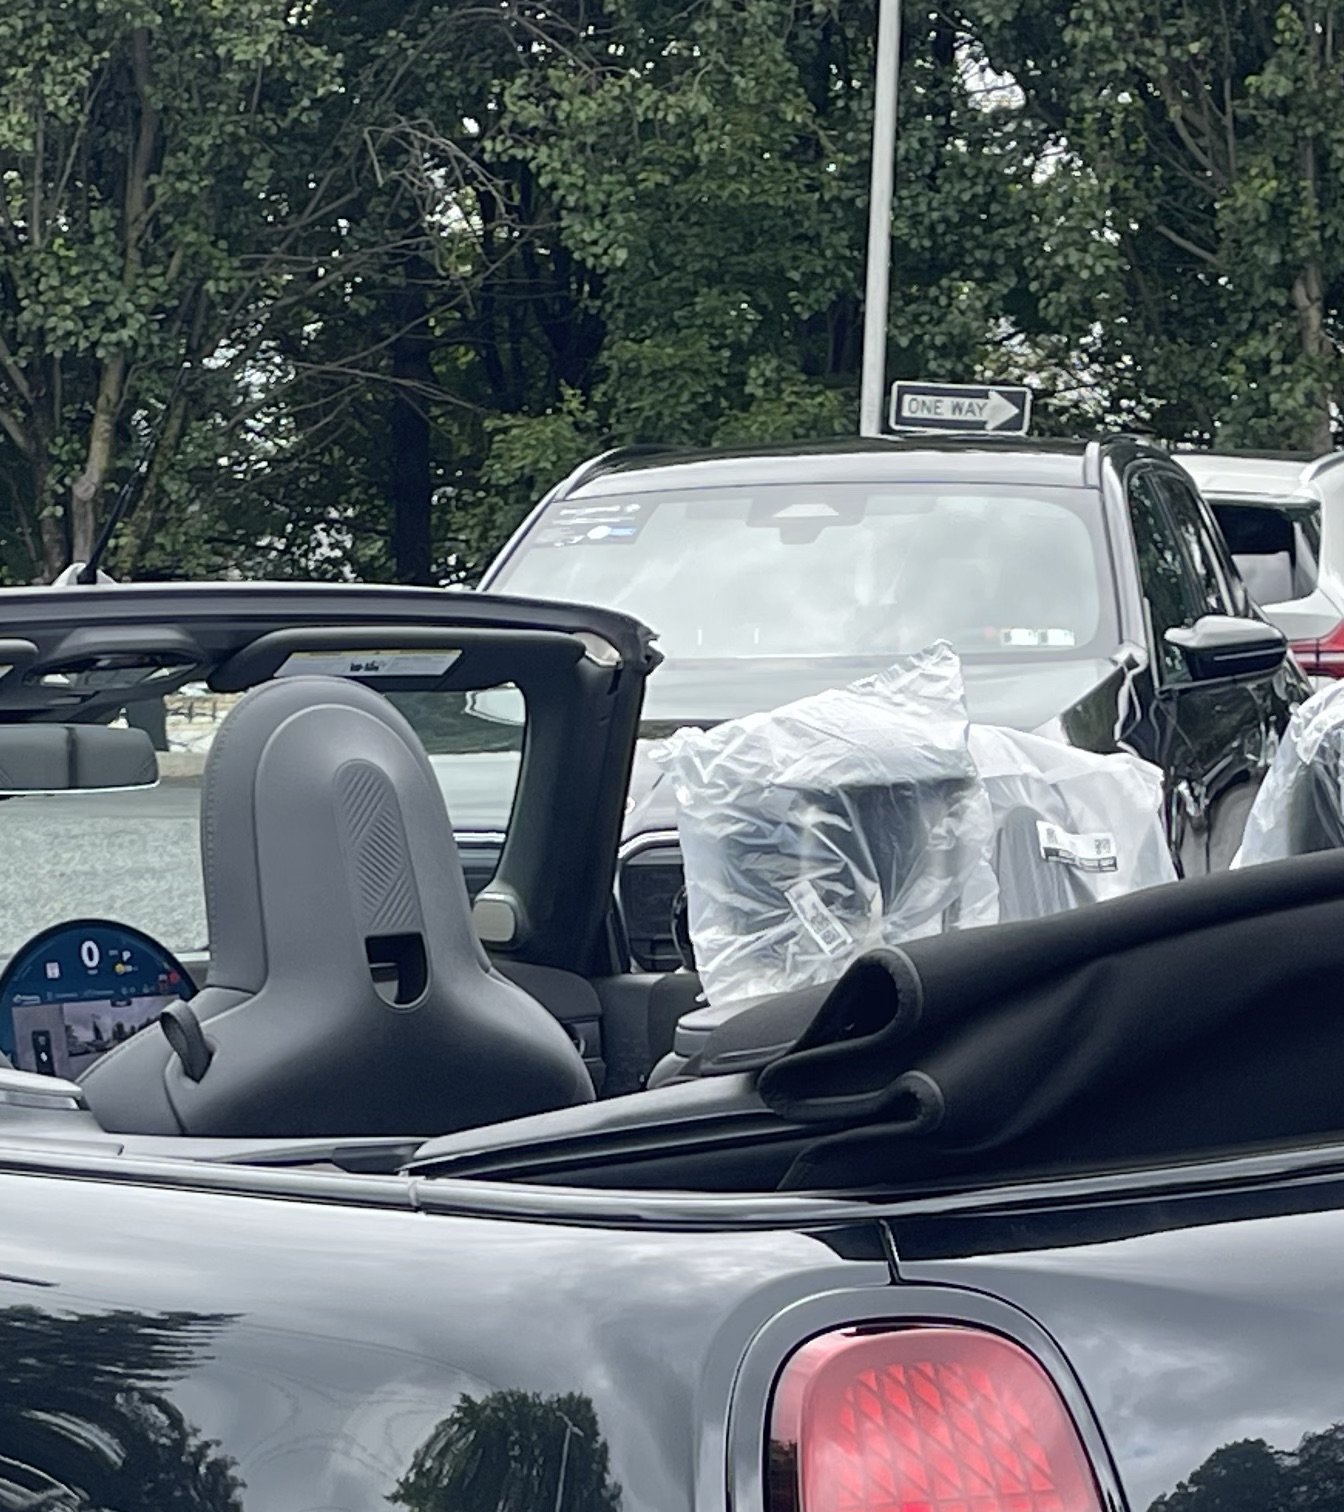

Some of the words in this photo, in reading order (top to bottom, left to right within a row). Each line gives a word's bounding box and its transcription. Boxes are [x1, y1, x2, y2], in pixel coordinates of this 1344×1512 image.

[908, 397, 944, 416] ONE
[951, 399, 988, 417] WAY
[80, 940, 100, 968] 0
